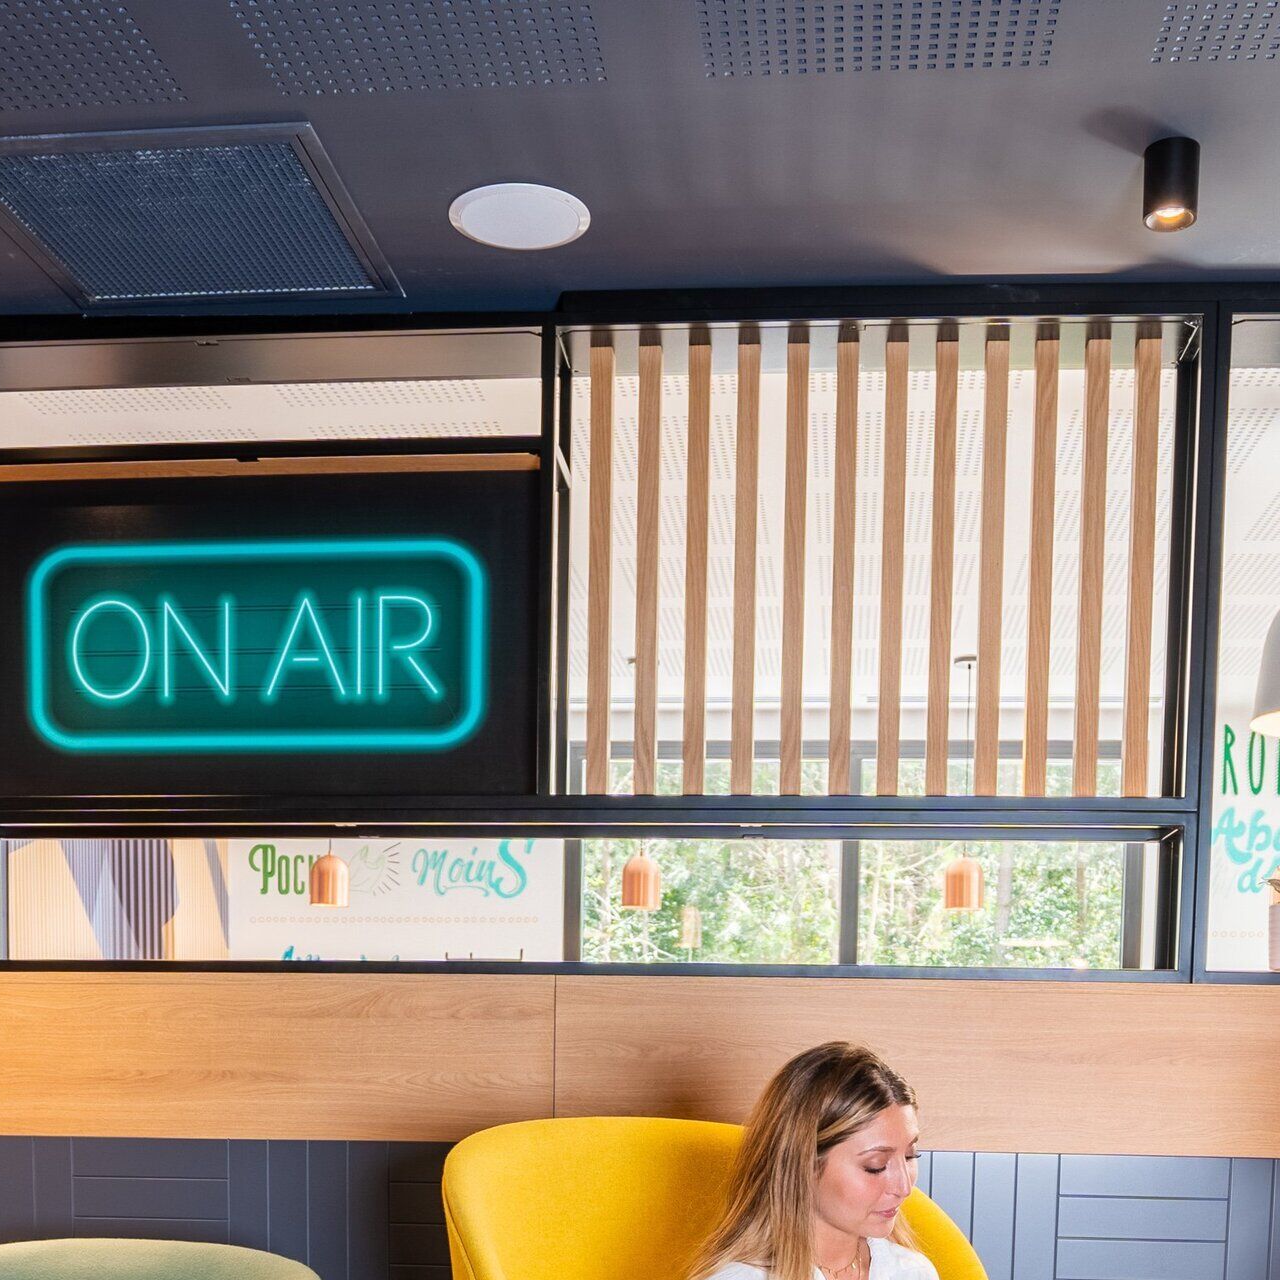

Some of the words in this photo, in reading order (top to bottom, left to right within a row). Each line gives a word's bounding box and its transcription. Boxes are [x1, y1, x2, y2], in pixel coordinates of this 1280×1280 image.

[71, 598, 233, 701] ON
[265, 594, 440, 698] AIR
[248, 844, 321, 895] POC
